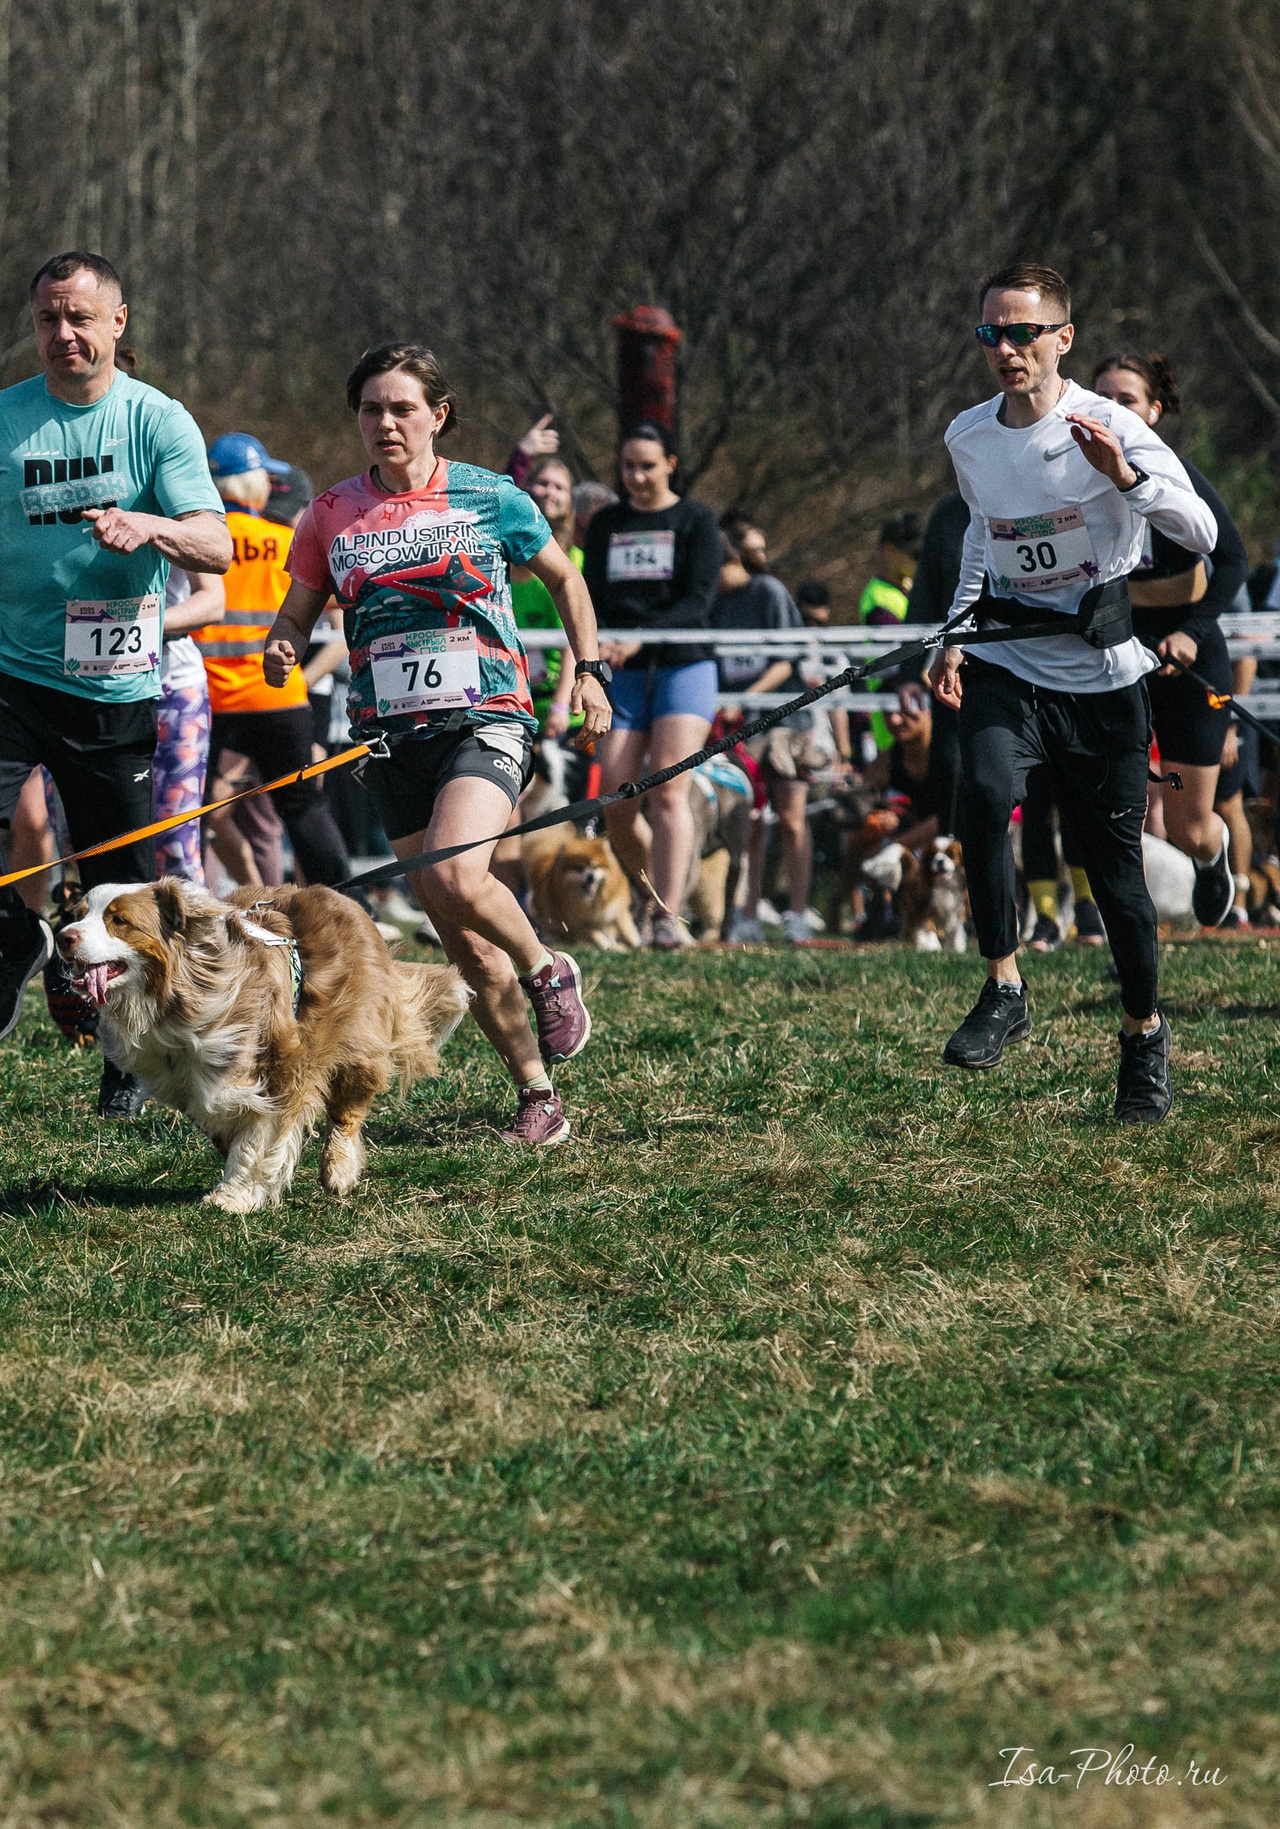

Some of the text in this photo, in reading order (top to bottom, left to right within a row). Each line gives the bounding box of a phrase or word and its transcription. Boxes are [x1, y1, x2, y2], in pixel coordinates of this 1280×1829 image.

[332, 543, 423, 573] MOSCOW
[1016, 541, 1057, 573] 30
[90, 625, 142, 656] 123
[401, 658, 442, 692] 76
